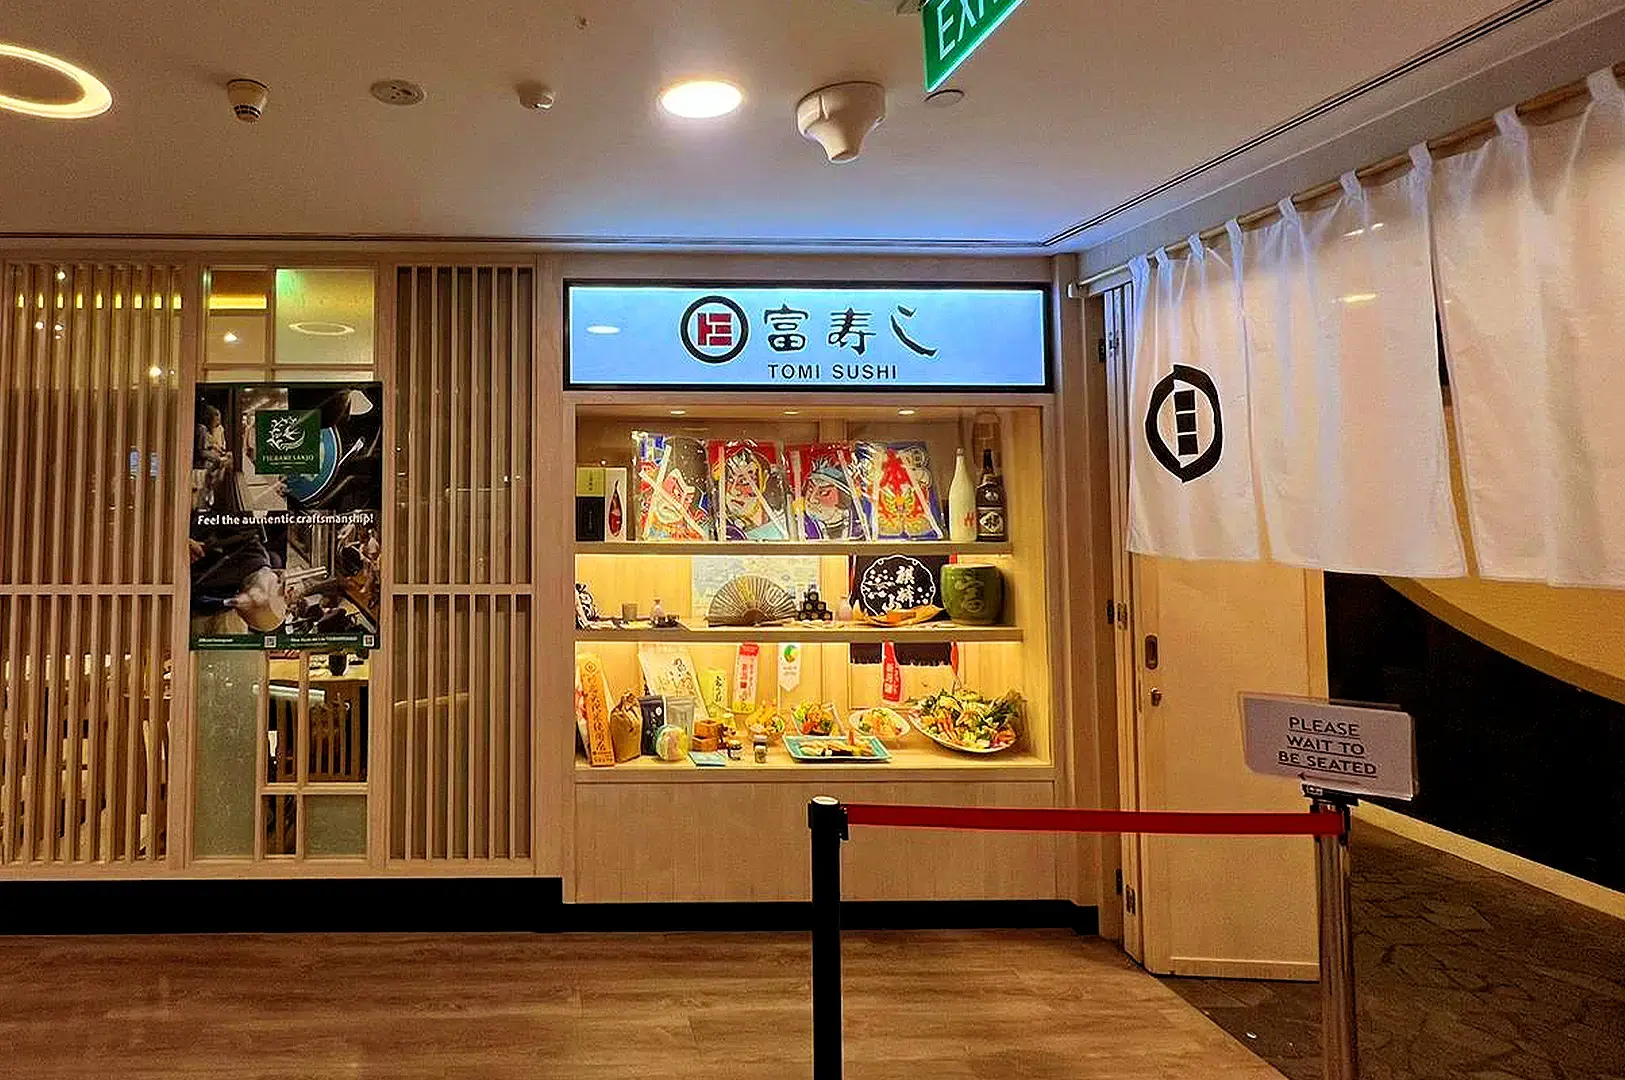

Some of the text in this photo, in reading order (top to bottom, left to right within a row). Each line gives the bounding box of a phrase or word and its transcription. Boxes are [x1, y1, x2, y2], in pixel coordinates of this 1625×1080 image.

[764, 304, 938, 357] 富寿し
[768, 364, 897, 379] TOMI SUSHI
[198, 512, 374, 527] Feel the authentic craftsmanship!
[1289, 716, 1361, 737] PLEASE
[1286, 734, 1365, 755] WAIT TO
[1278, 750, 1377, 775] BE SEATED
